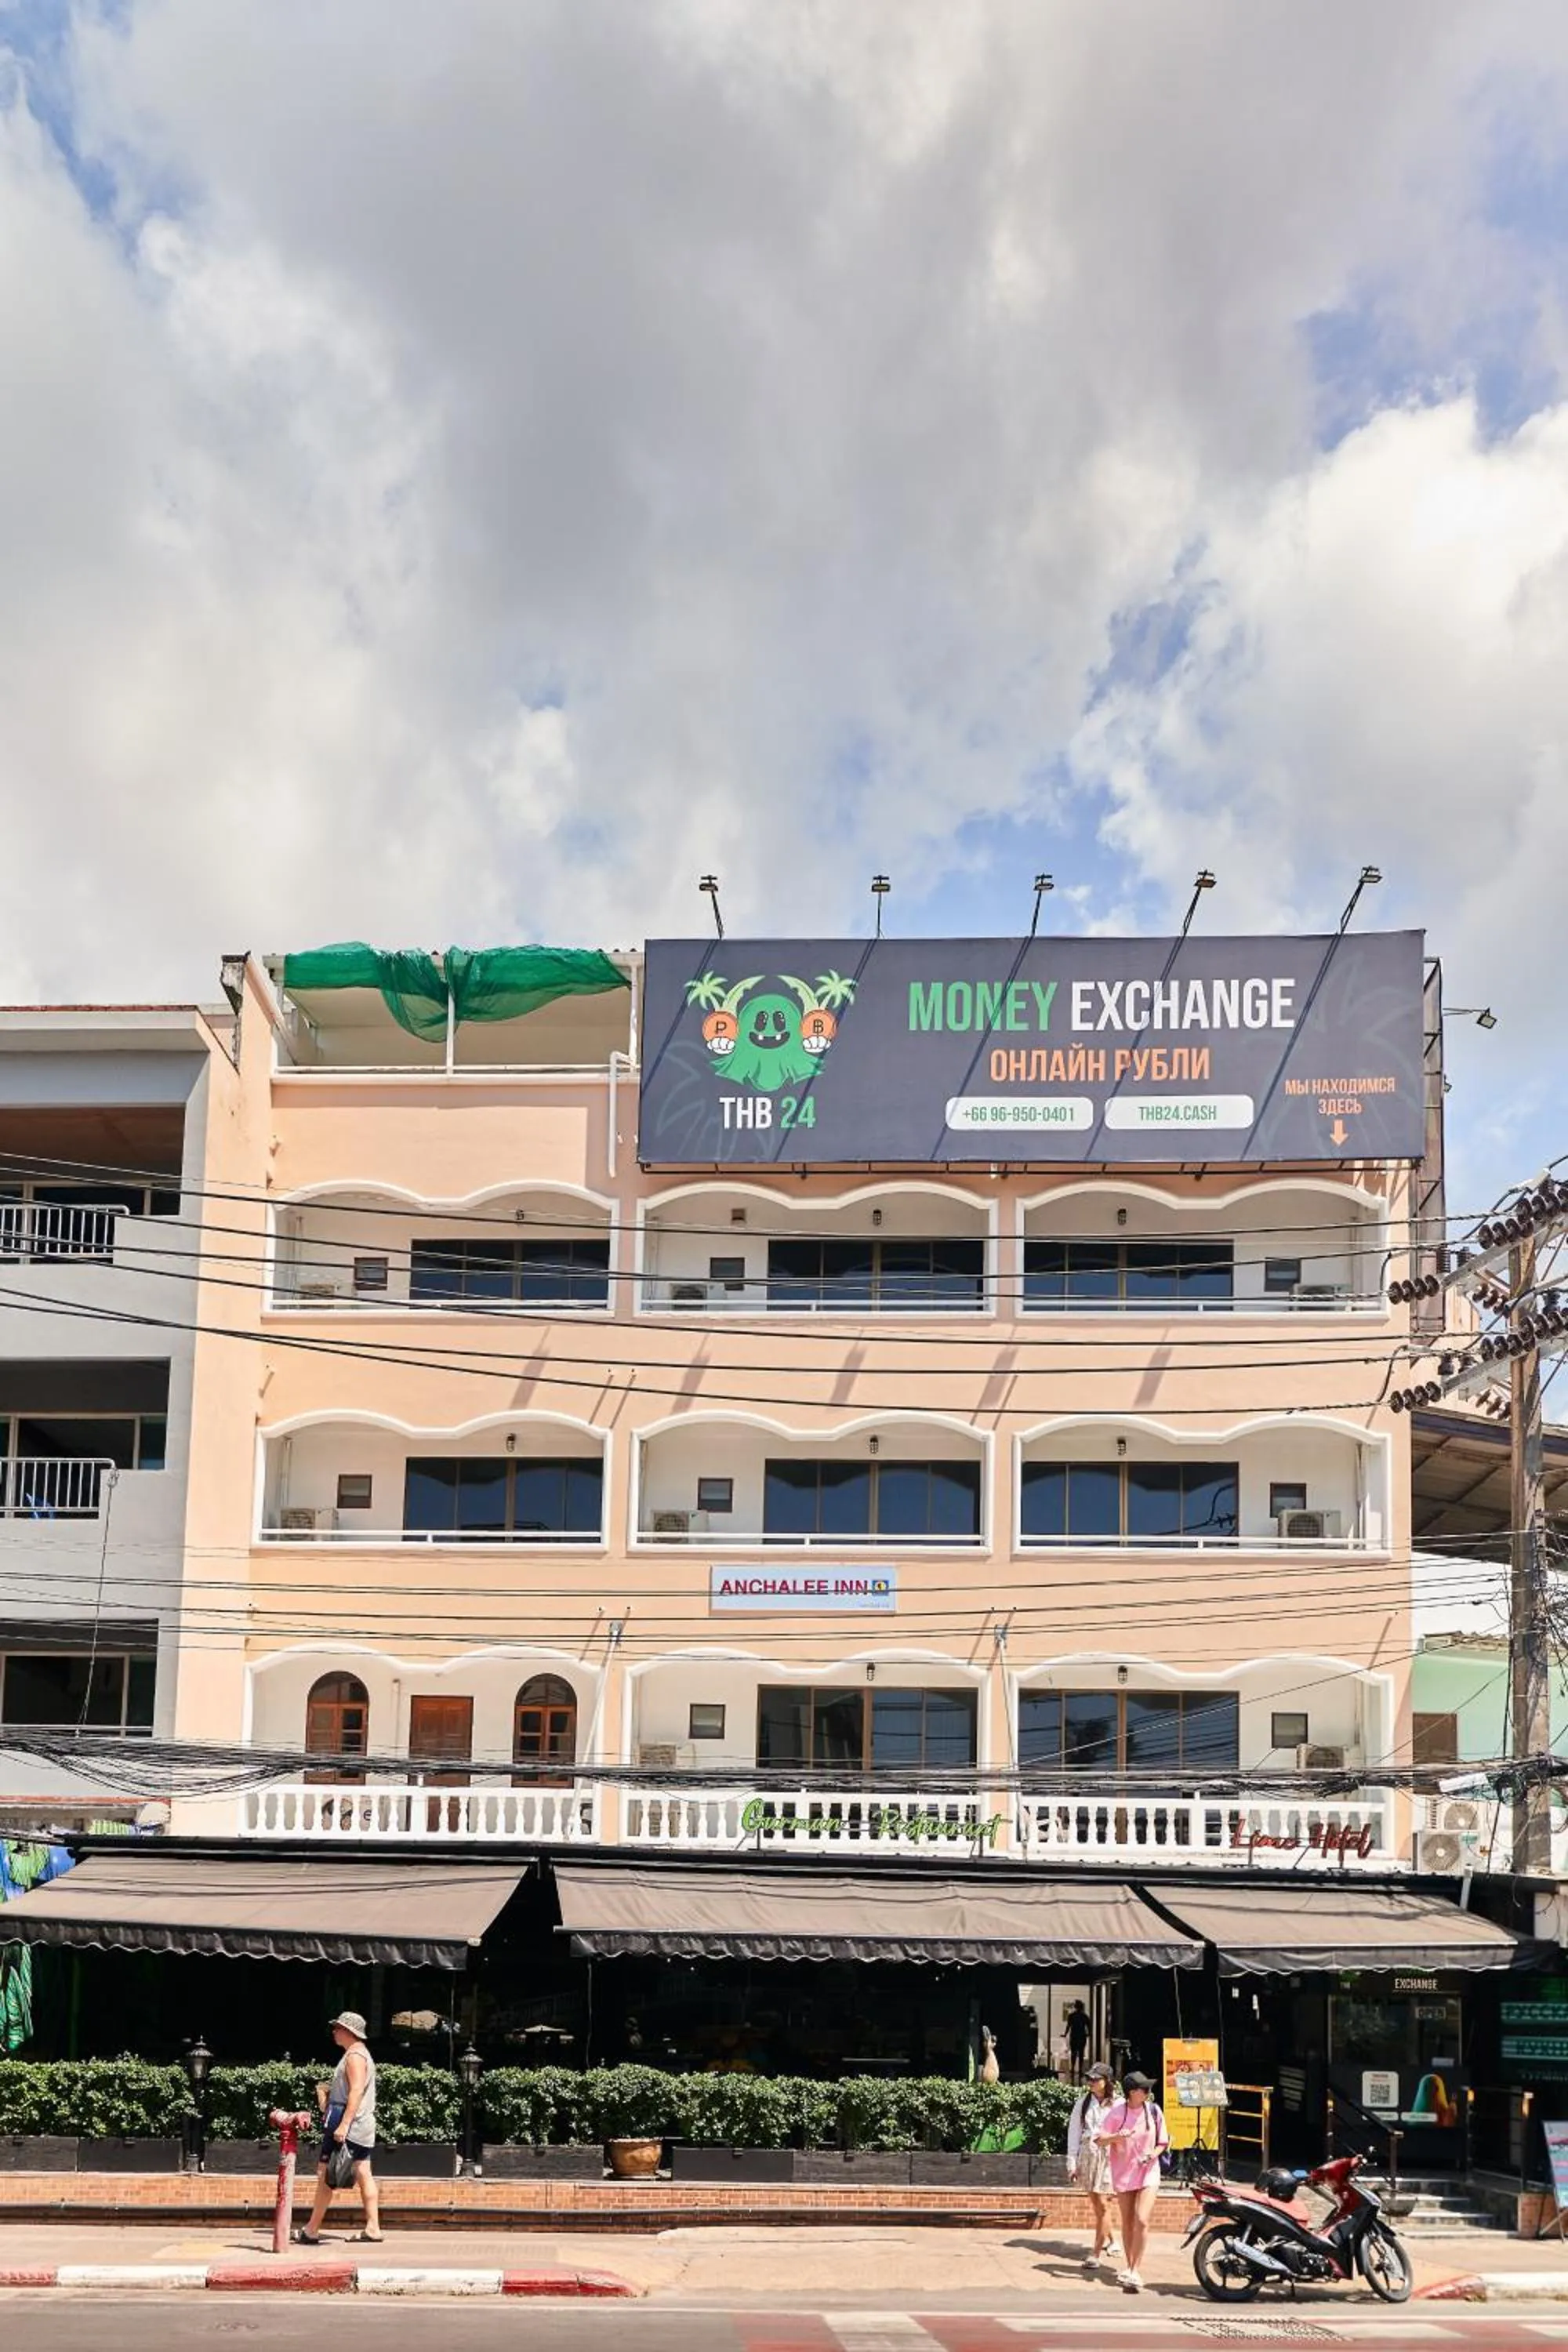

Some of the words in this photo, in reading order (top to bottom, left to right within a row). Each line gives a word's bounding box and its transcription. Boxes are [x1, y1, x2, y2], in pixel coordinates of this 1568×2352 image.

[909, 982, 1058, 1032] MONEY
[1071, 978, 1297, 1031] EXCHANGE
[990, 1043, 1105, 1082] ОНЛАЙН
[1114, 1047, 1210, 1081] РУБЛИ
[1285, 1079, 1308, 1094] МЫ
[1312, 1077, 1396, 1094] НАХОДИМСЯ
[719, 1098, 772, 1129] THB
[780, 1096, 816, 1128] 24
[990, 1106, 1075, 1122] 96-950-0401
[1138, 1105, 1217, 1120] THB24.CASH
[1318, 1098, 1362, 1115] ЗДЕСЬ
[720, 1579, 828, 1595] ANCHALEE
[834, 1580, 868, 1595] INN
[1394, 1978, 1439, 1990] EXCHANGE
